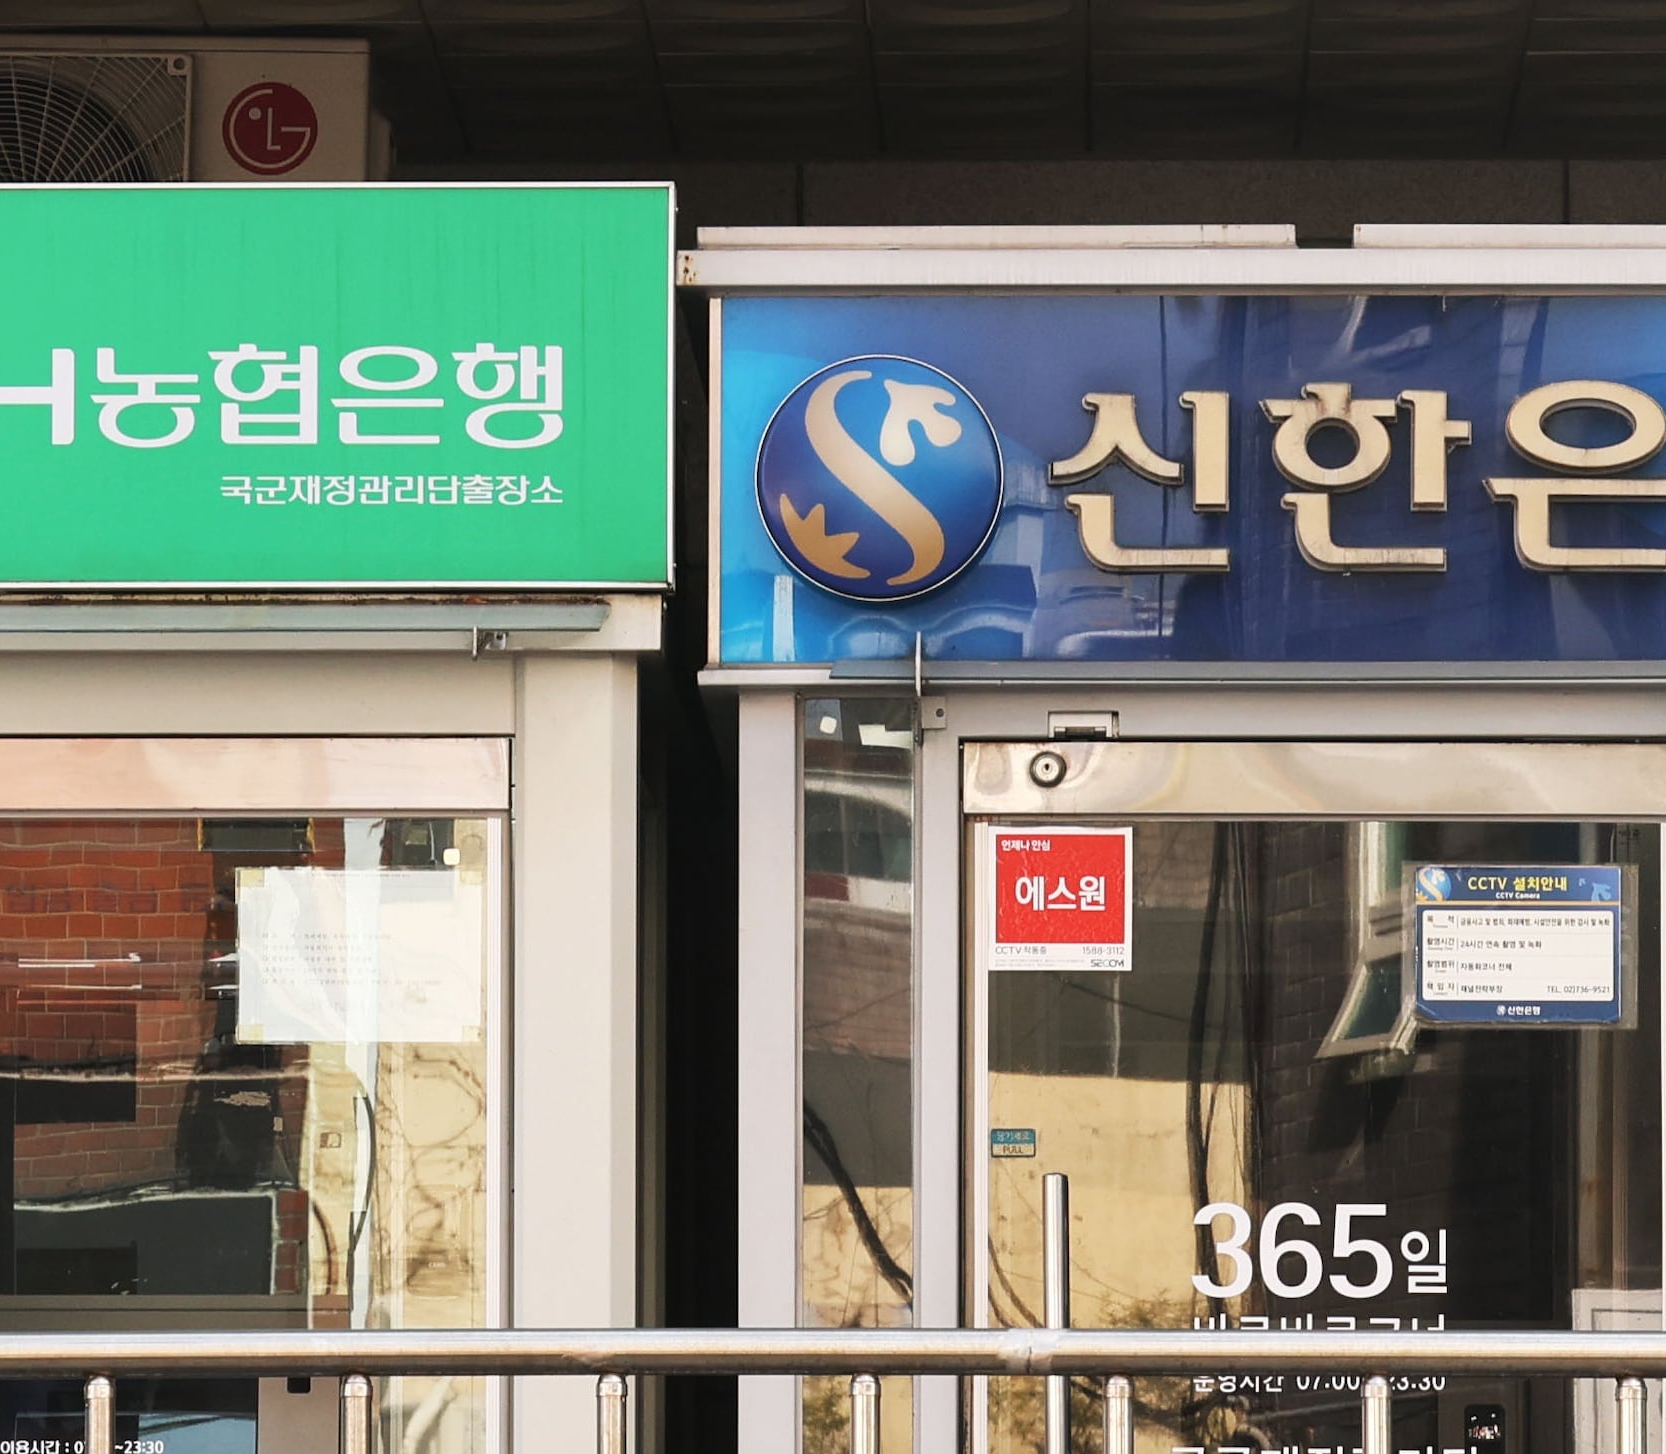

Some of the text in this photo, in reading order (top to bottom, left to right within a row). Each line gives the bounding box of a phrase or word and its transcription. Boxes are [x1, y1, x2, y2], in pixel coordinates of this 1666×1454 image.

[220, 473, 565, 507] 국군재정관리단출장소
[1001, 840, 1050, 851] 언제나 안심
[1468, 876, 1568, 892] CCTV 설치안내
[1015, 875, 1105, 911] 에스원
[995, 946, 1021, 955] CCTV
[1082, 946, 1125, 955] 1588-3112
